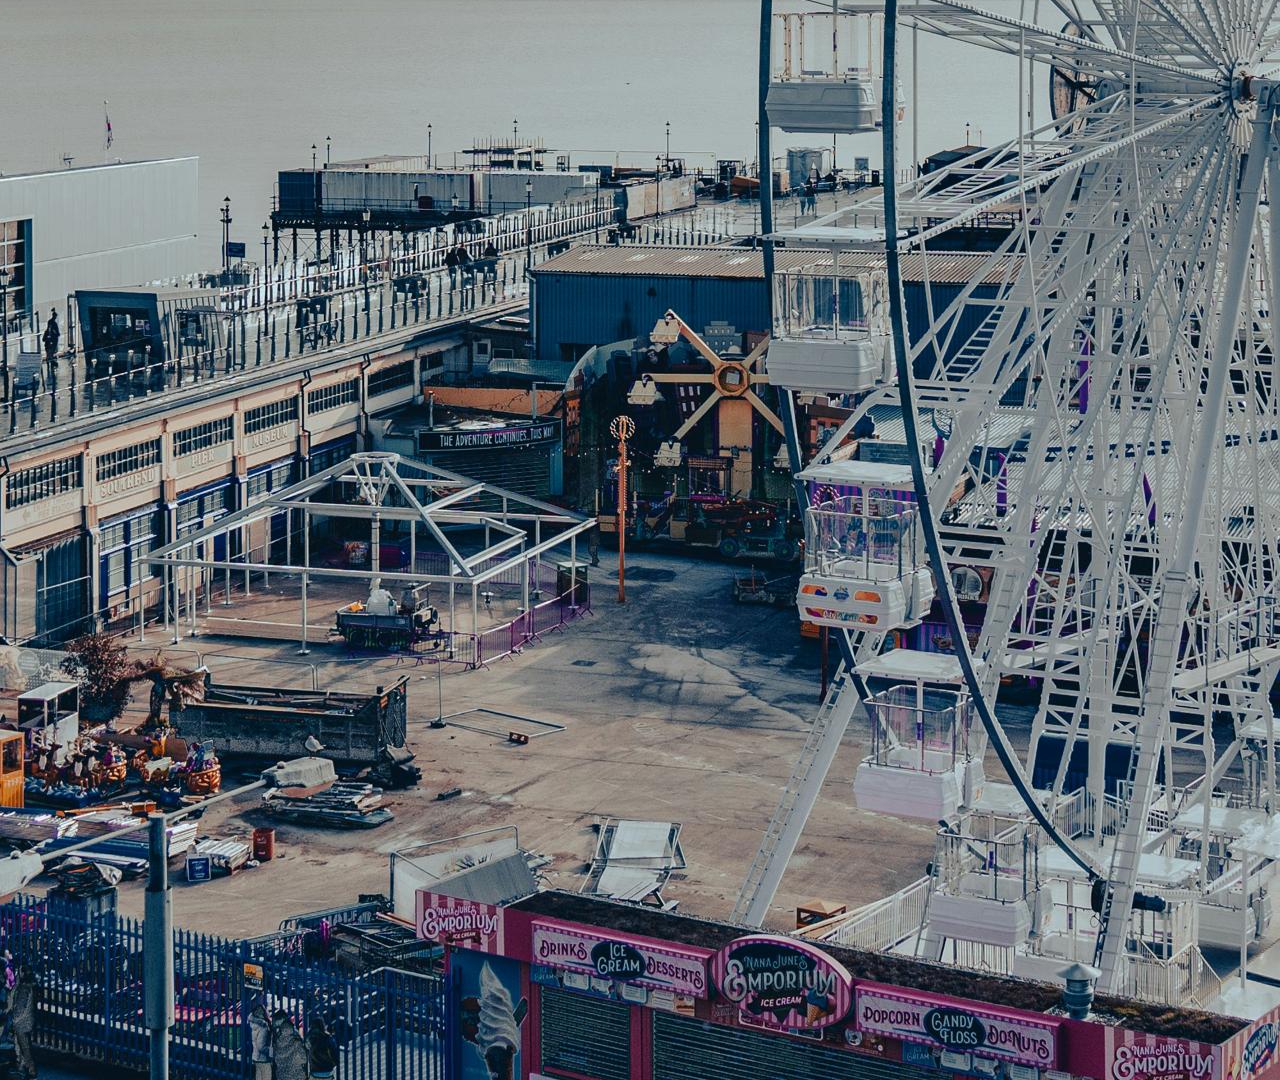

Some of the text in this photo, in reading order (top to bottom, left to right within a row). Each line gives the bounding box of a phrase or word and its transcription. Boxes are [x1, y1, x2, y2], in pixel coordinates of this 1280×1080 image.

[252, 425, 288, 449] MUSEUM
[440, 434, 453, 447] THE
[455, 431, 493, 447] ADVENTURE
[530, 428, 542, 440] THIS
[191, 449, 215, 468] PIER
[100, 469, 155, 498] SOUTHEND
[422, 908, 499, 939] EMPORIUM
[540, 940, 587, 960] DRINKS
[609, 942, 627, 959] ICE
[597, 957, 640, 974] CREAM
[646, 956, 704, 989] DESSERTS
[743, 955, 771, 971] NANA
[723, 959, 838, 1002] EMPORIUM
[760, 997, 802, 1007] ICE CREAM
[863, 1006, 920, 1026] POPCORN
[931, 1012, 974, 1030] CANDY
[940, 1028, 978, 1045] FLOSS
[1131, 1045, 1156, 1057] NANA
[1113, 1046, 1215, 1080] EMPORIUM
